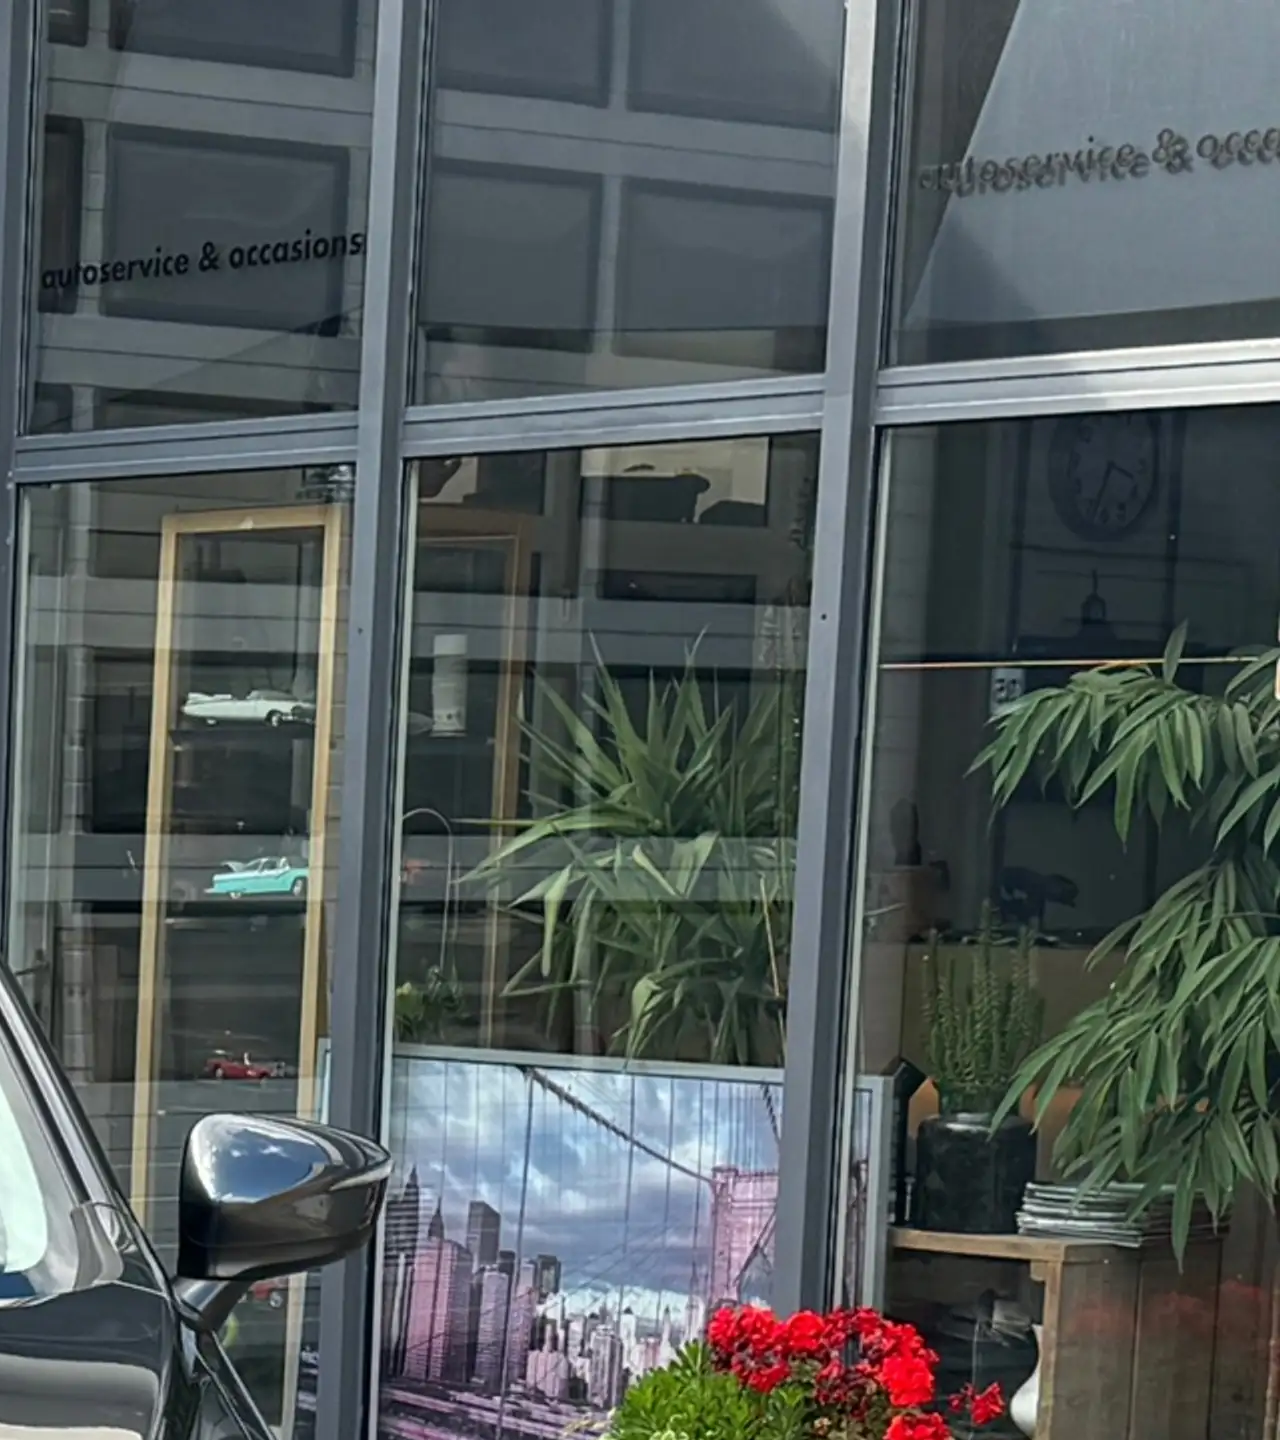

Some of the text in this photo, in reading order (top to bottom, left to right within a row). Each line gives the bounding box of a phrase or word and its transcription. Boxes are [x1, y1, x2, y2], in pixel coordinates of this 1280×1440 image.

[41, 227, 365, 290] autoservice & occasions
